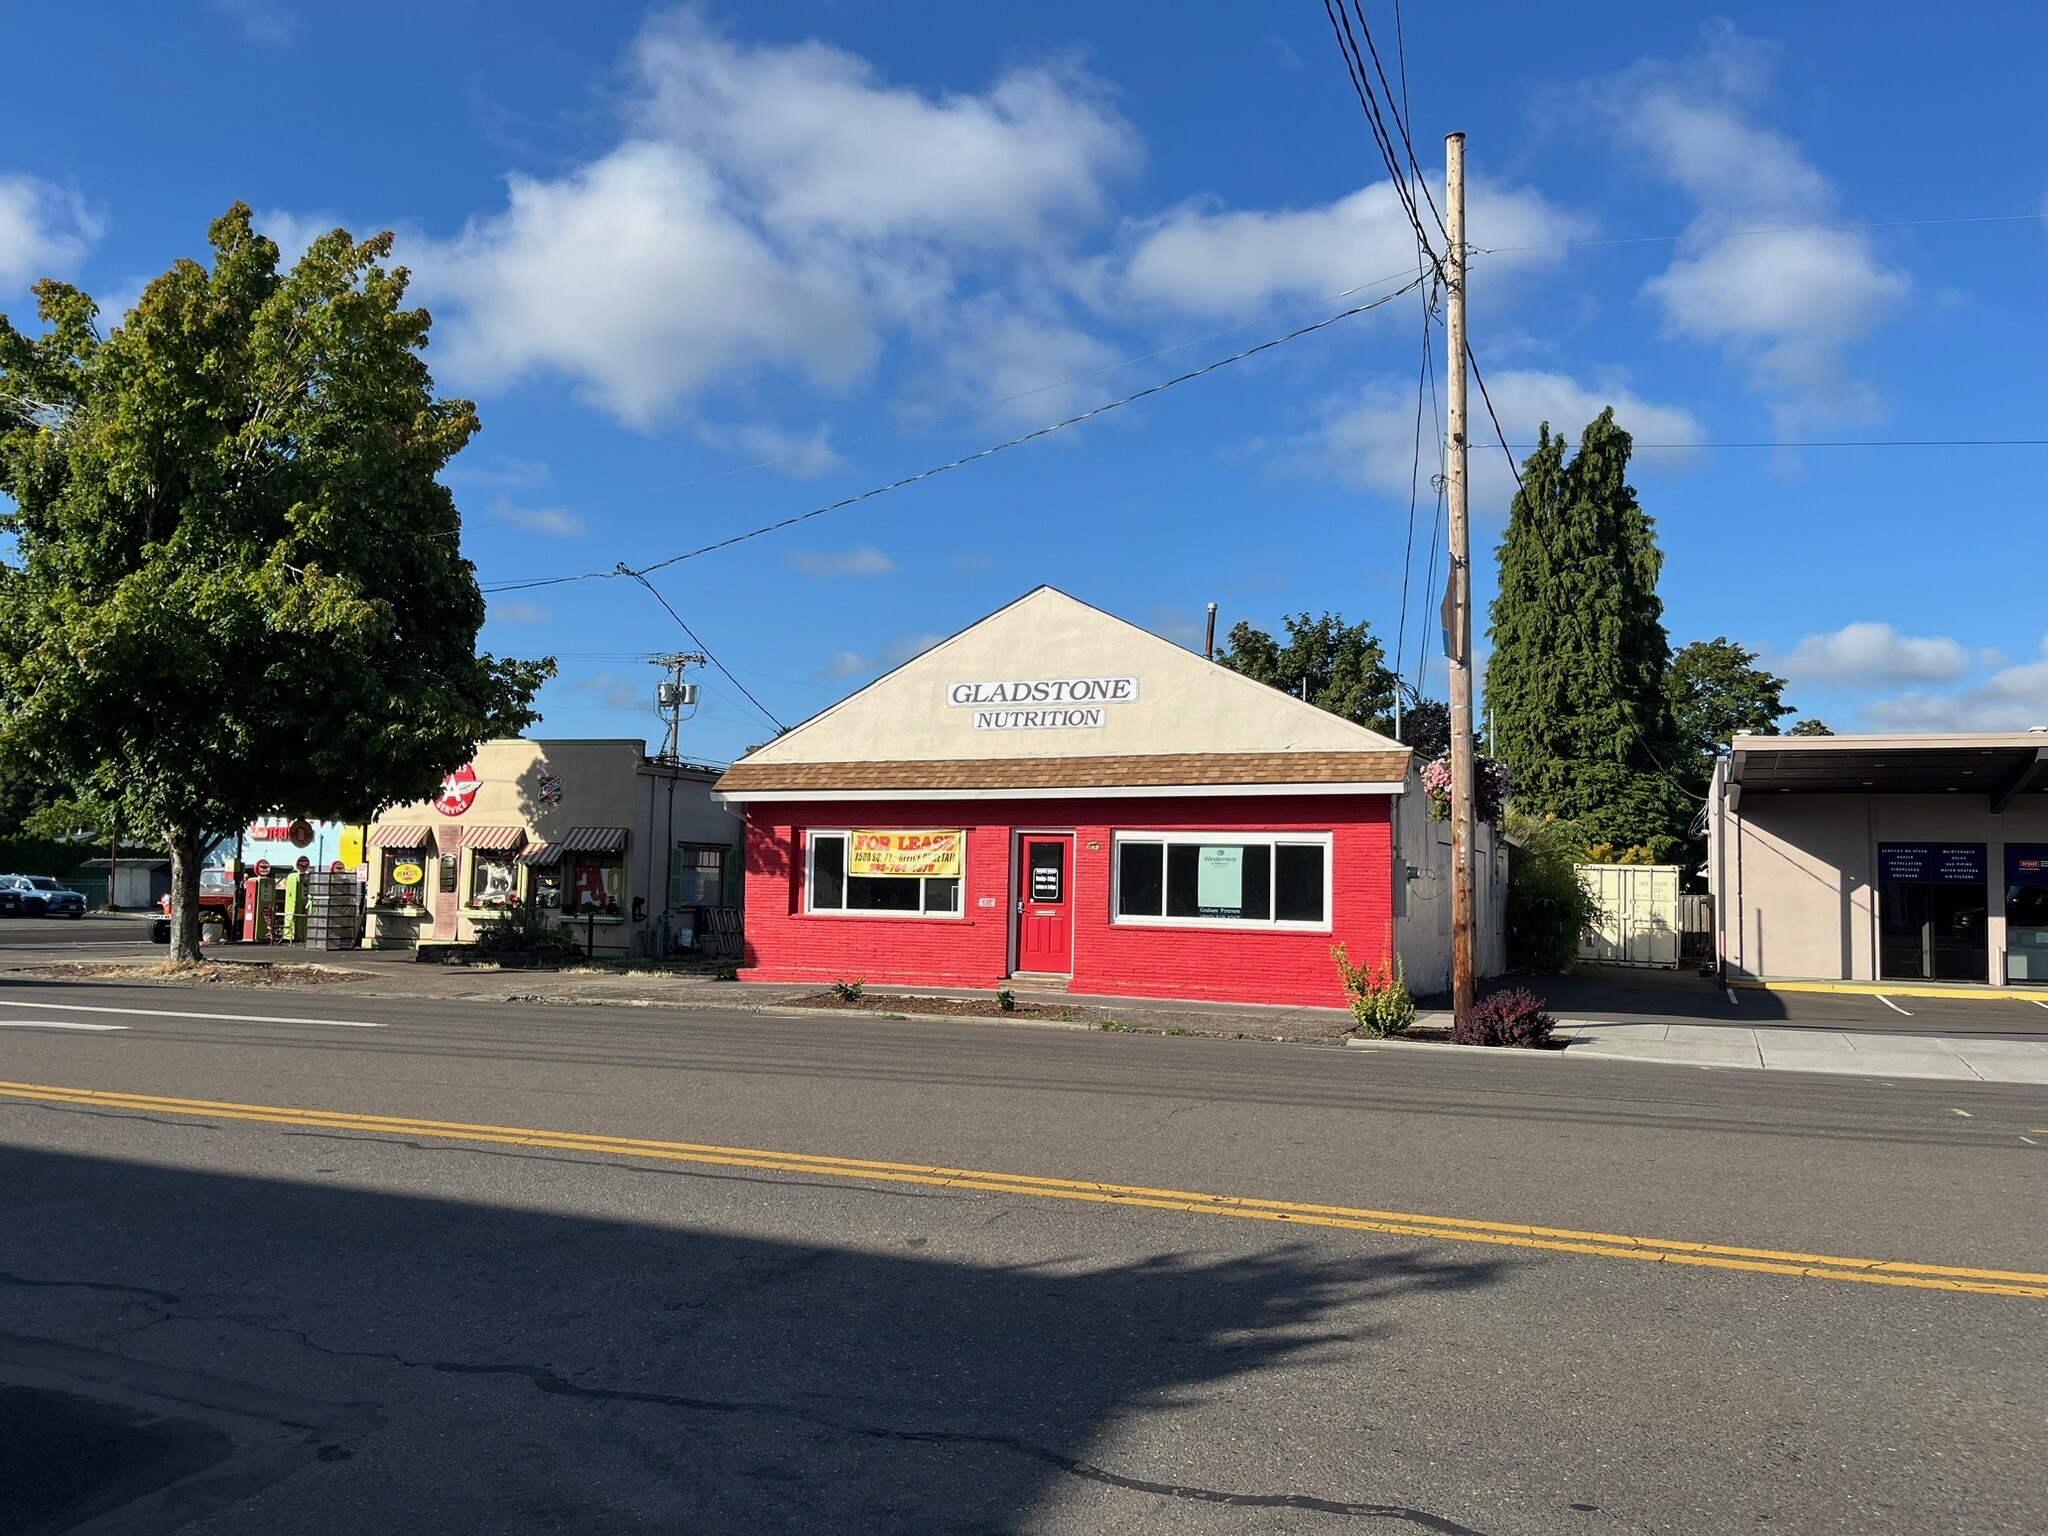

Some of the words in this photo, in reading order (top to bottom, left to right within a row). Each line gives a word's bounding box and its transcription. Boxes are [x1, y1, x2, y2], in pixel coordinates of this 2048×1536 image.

[952, 679, 1131, 704] GLADSTONE
[976, 709, 1101, 728] NUTRITION
[436, 800, 468, 814] SERVICE
[855, 836, 891, 851] FOR
[898, 836, 956, 851] LEASE
